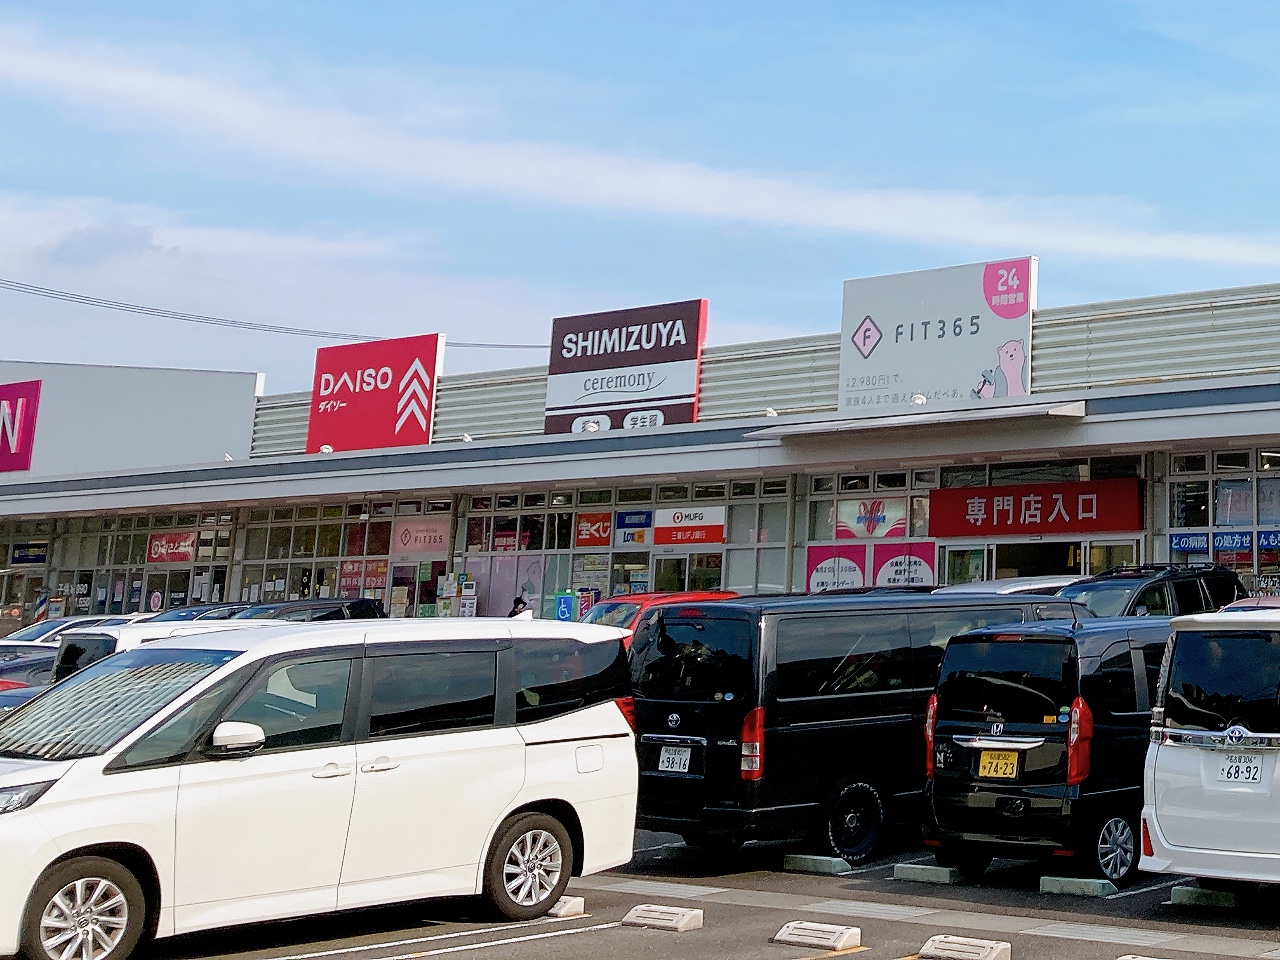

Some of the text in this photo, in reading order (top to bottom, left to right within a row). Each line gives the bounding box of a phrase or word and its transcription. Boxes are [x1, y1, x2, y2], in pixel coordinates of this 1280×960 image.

[997, 268, 1020, 291] 24
[561, 319, 687, 359] SHIMIZUYA
[894, 315, 981, 343] FIT365
[319, 366, 393, 396] DAISO
[583, 370, 656, 392] ceremony
[318, 400, 347, 412] ダイソー
[684, 512, 703, 521] MUFG
[965, 493, 1098, 526] 専門店入口
[578, 520, 610, 539] 宝くじ
[665, 756, 688, 770] 98-16
[987, 761, 1015, 775] 74-23
[1226, 765, 1259, 780] 68-92
